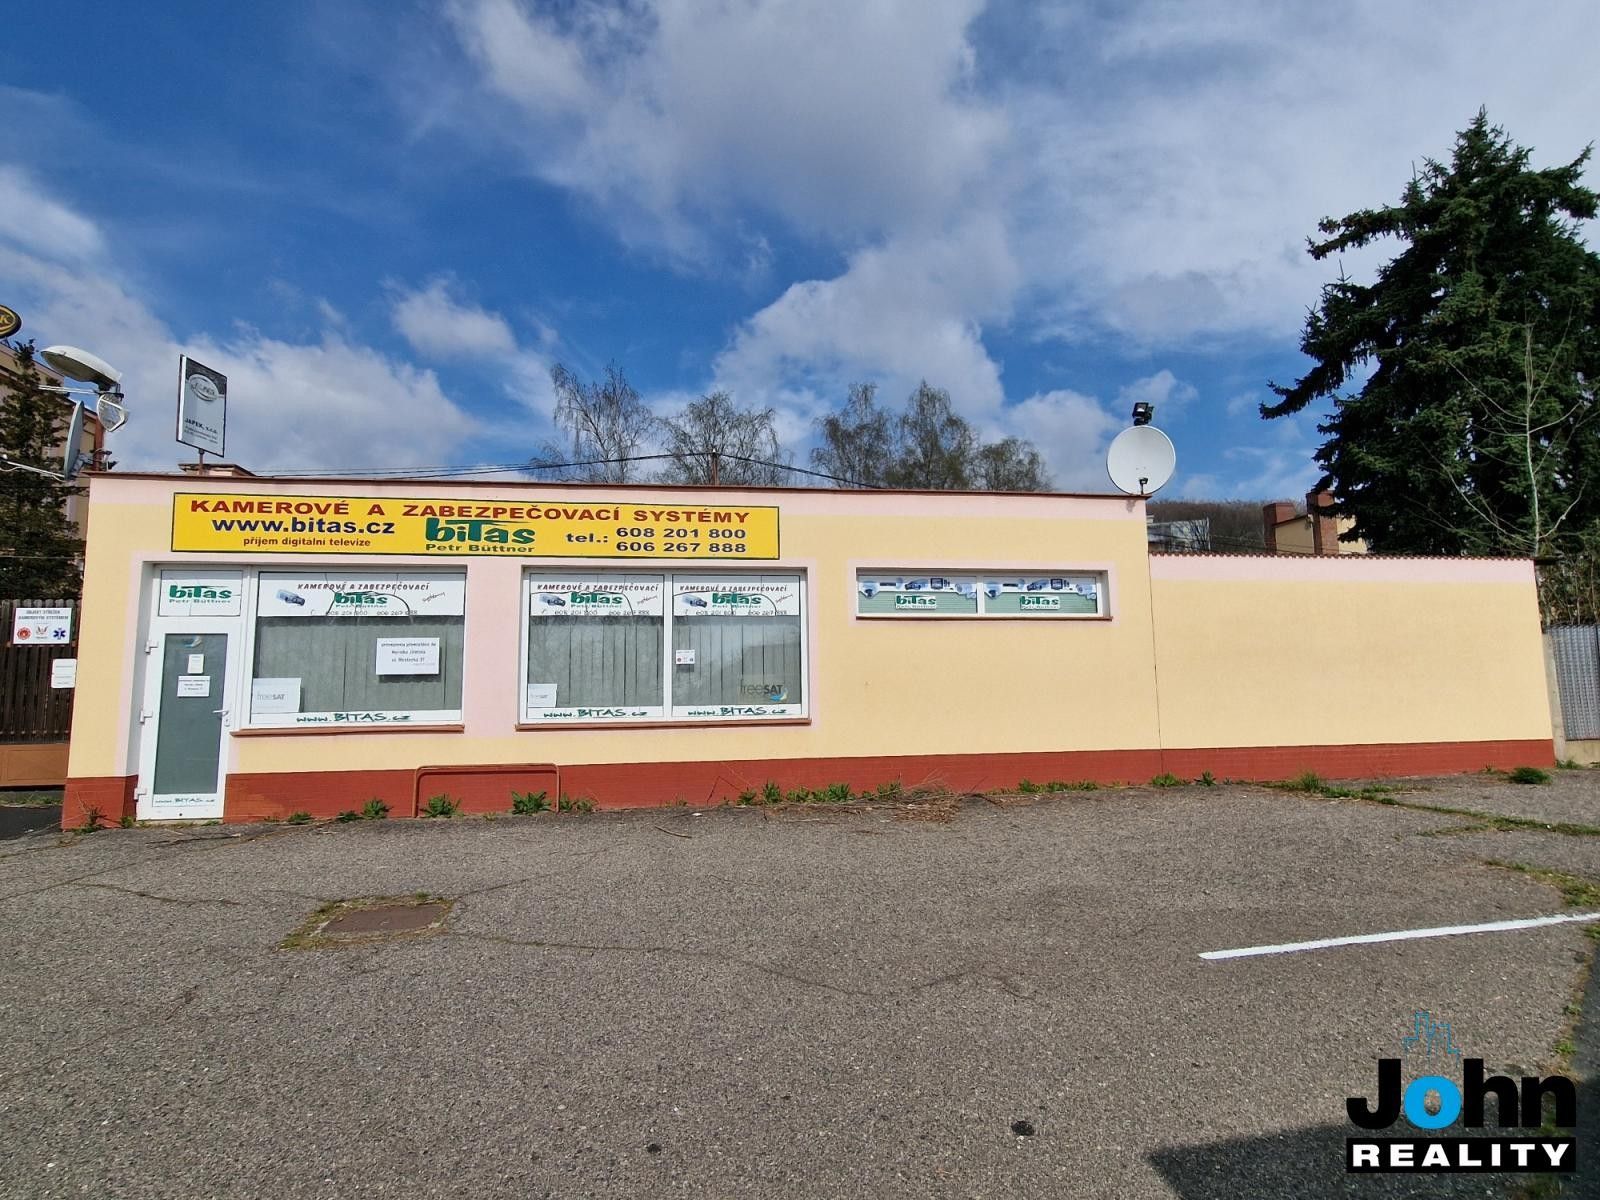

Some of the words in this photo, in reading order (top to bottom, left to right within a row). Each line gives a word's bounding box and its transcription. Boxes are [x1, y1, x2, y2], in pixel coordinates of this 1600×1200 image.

[190, 500, 349, 515] KAMEROVÉ
[367, 504, 385, 515] A
[402, 504, 620, 521] ZABEZPEČOVACÍ
[633, 508, 750, 523] SYSTÉMY
[212, 517, 395, 534] www.bitas.cz
[566, 533, 608, 543] tel.:
[616, 527, 655, 538] 608
[663, 528, 699, 538] 201
[708, 528, 746, 539] 800
[329, 538, 371, 547] televize
[425, 543, 463, 551] Petr
[616, 541, 655, 552] 606
[663, 542, 701, 552] 267
[708, 543, 746, 553] 888
